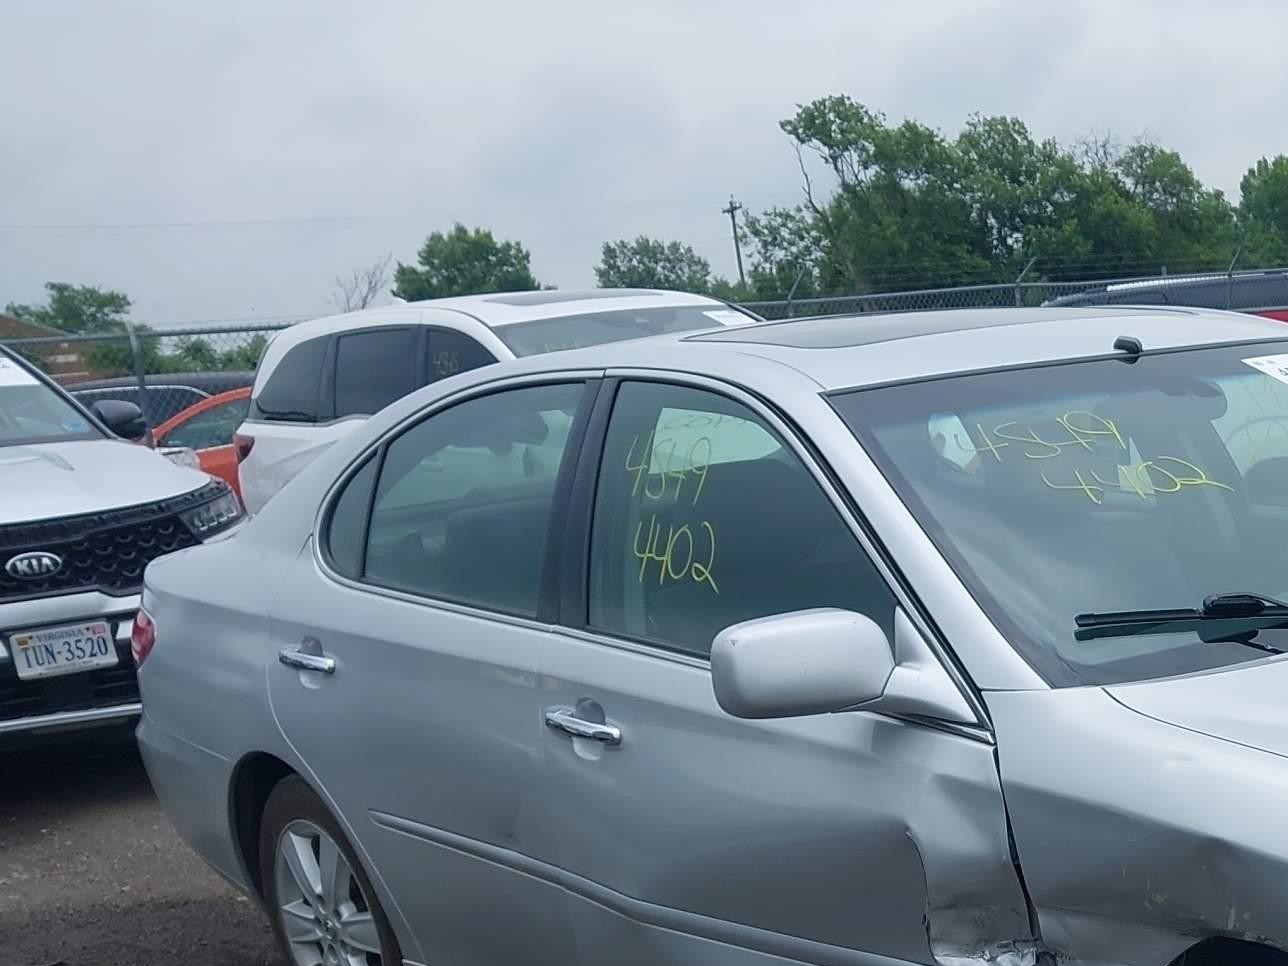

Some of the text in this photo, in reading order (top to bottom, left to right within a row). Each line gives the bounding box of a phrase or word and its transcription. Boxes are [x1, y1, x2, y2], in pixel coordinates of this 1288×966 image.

[955, 410, 1127, 461] 4549
[625, 430, 712, 505] 4549
[1041, 455, 1235, 504] 4402
[13, 556, 55, 576] KIA
[634, 513, 719, 594] 4402
[21, 635, 109, 669] TUN-3520
